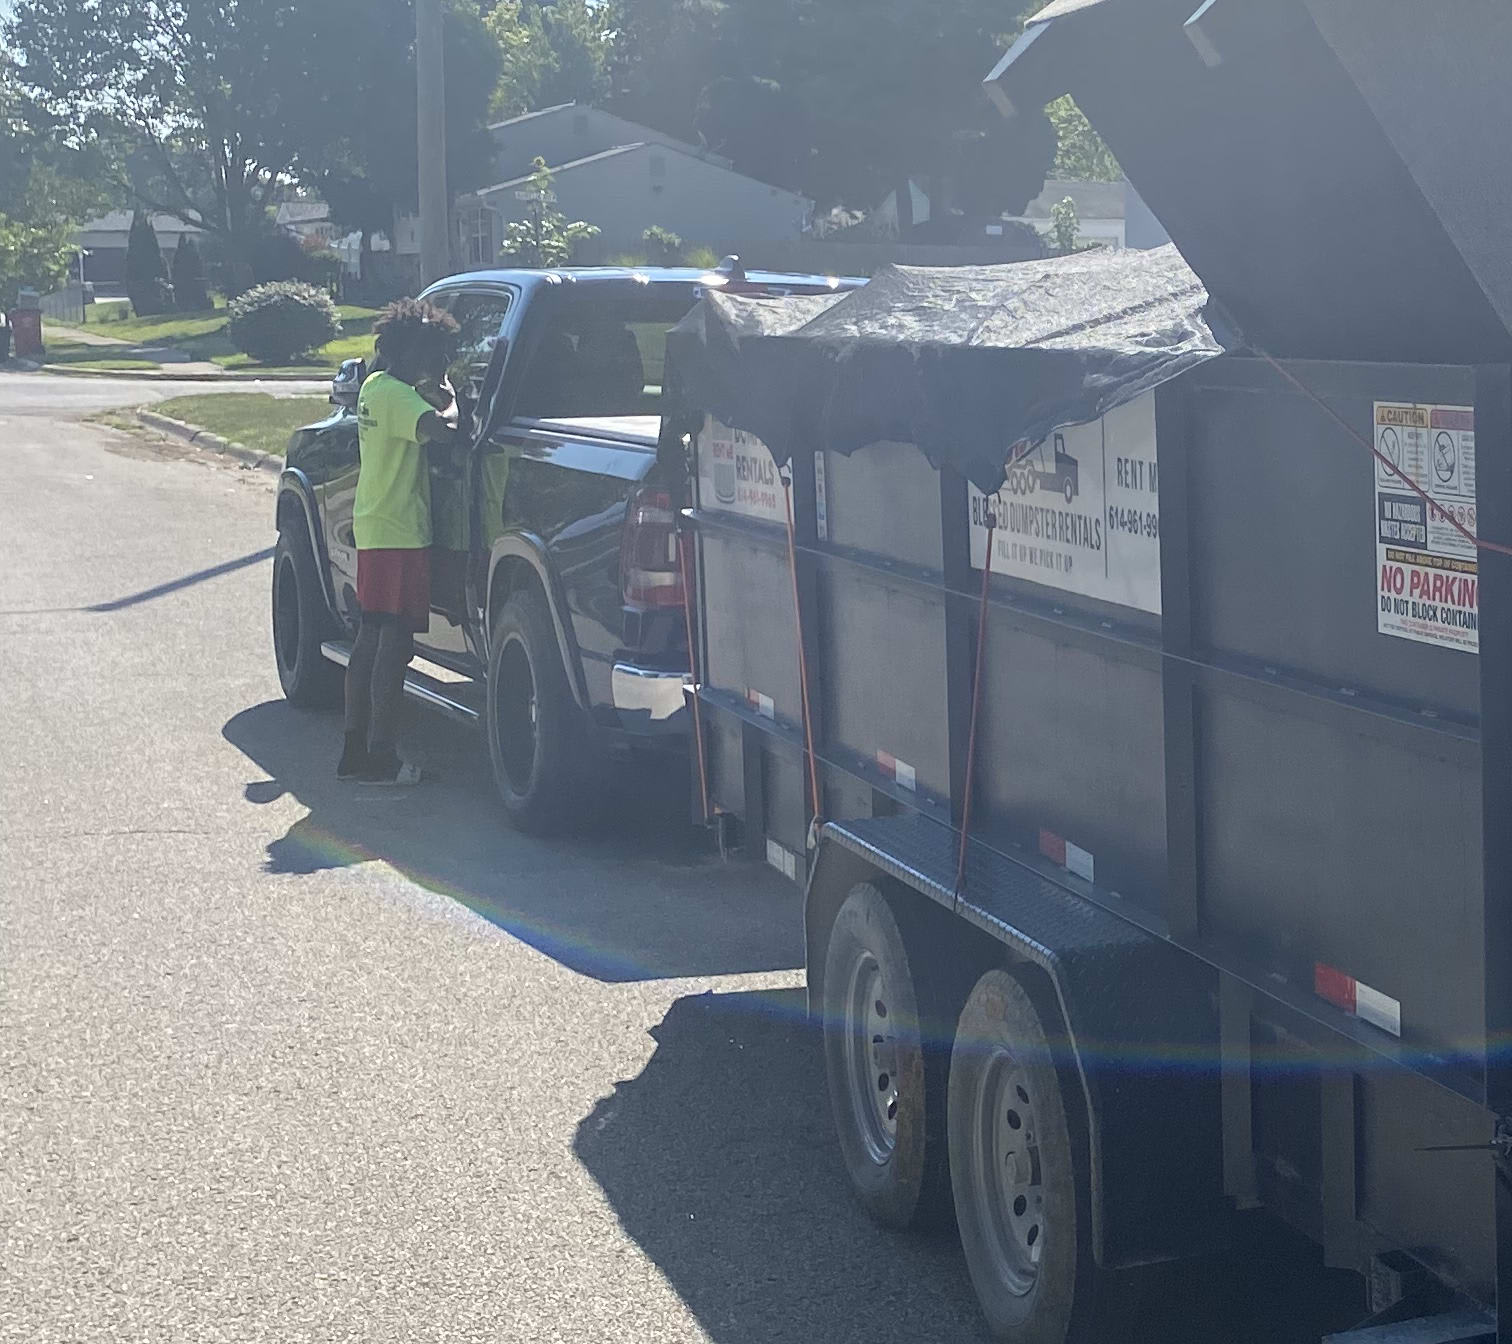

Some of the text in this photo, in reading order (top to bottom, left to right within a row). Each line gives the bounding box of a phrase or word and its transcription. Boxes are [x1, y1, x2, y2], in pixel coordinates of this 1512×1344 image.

[1387, 410, 1425, 425] CAUTION
[735, 455, 775, 486] RENTALS
[1116, 457, 1144, 491] RENT
[1009, 502, 1057, 542] DUMPSTER
[1058, 510, 1102, 551] RENTALS
[1011, 542, 1019, 562] IT
[1028, 546, 1038, 566] WE
[1055, 552, 1063, 572] IT
[1064, 554, 1073, 574] UP
[1381, 564, 1478, 609] NO PARKIN
[1381, 595, 1392, 613] DO
[1394, 598, 1409, 617] NOT
[1411, 601, 1438, 623] BLOCK
